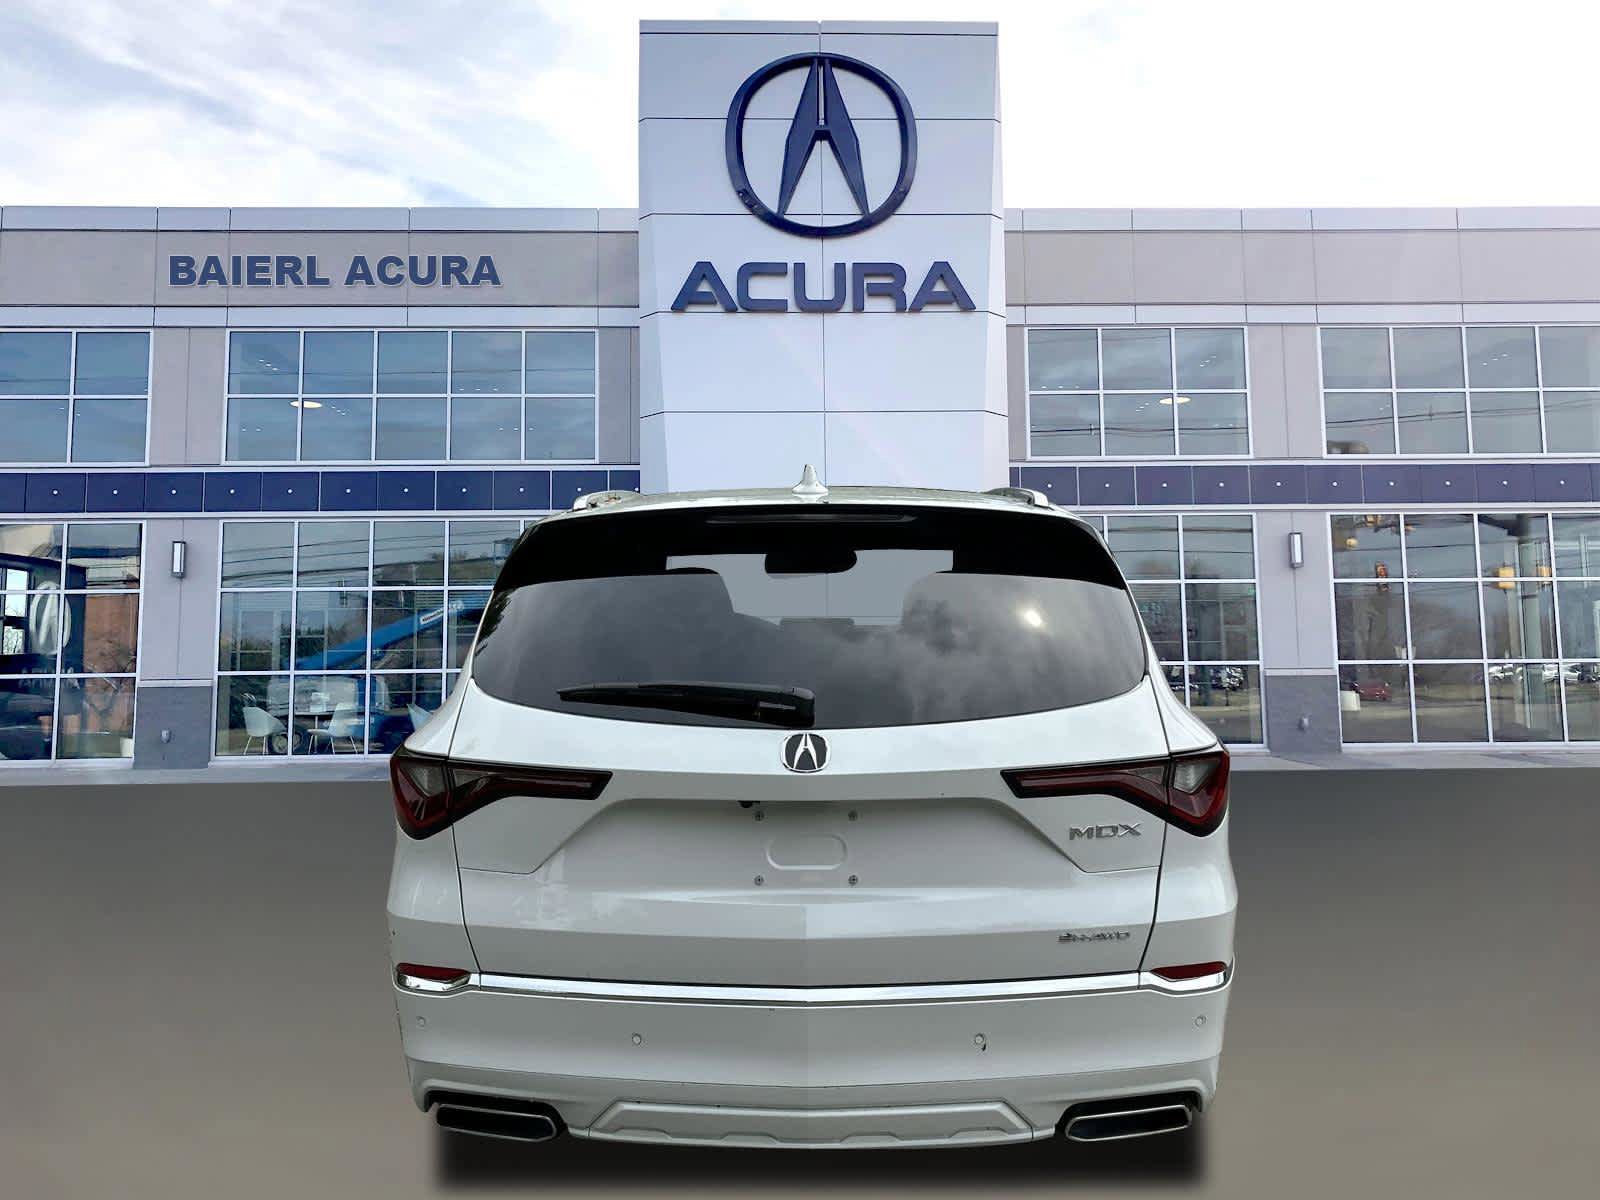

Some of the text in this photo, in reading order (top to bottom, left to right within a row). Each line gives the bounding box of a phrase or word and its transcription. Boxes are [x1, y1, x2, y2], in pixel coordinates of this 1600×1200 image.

[169, 255, 502, 287] BAIERL ACURA
[671, 261, 977, 312] ACURA
[1069, 823, 1141, 840] MDX
